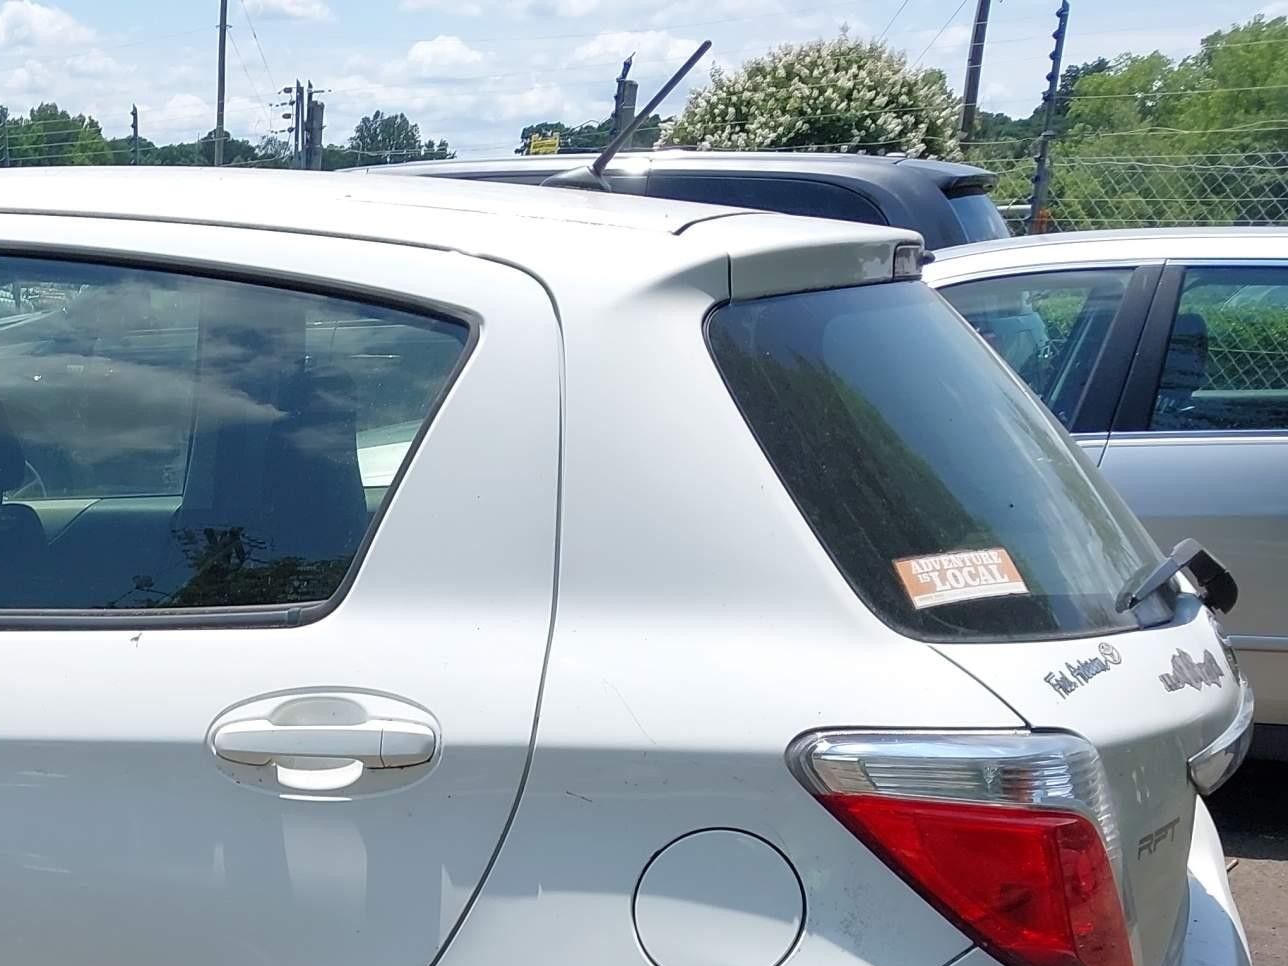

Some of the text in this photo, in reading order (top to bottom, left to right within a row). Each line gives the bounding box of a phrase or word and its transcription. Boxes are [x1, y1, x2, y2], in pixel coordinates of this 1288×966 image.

[912, 551, 1002, 574] ADVENTURE
[917, 565, 1009, 591] IS LOCAL
